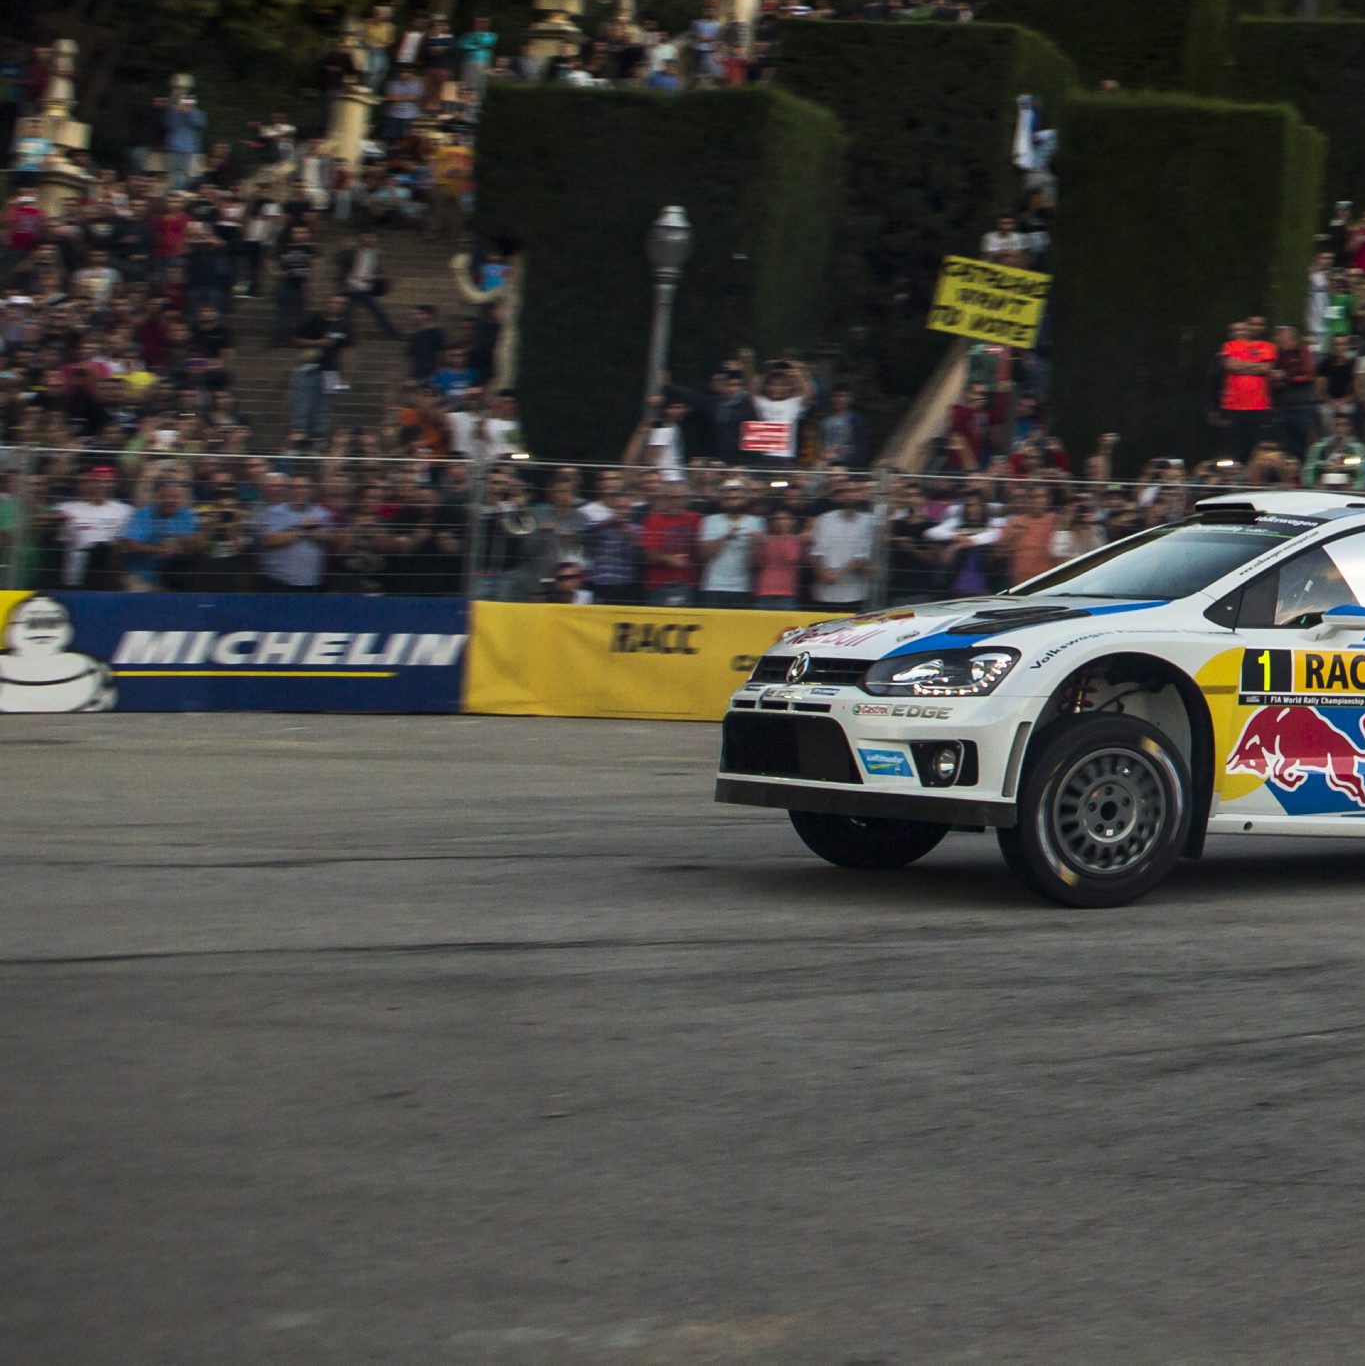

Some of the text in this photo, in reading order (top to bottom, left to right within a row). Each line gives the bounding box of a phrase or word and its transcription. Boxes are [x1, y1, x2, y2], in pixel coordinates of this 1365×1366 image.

[112, 631, 468, 665] MICHELIN
[611, 622, 702, 654] RACC
[1029, 629, 1114, 670] Volkswagen
[1258, 649, 1271, 691] 1
[892, 705, 953, 720] EDGE
[1270, 695, 1282, 704] FIA
[1283, 696, 1302, 704] World
[1303, 696, 1320, 706] Rally
[1321, 697, 1365, 706] Championship
